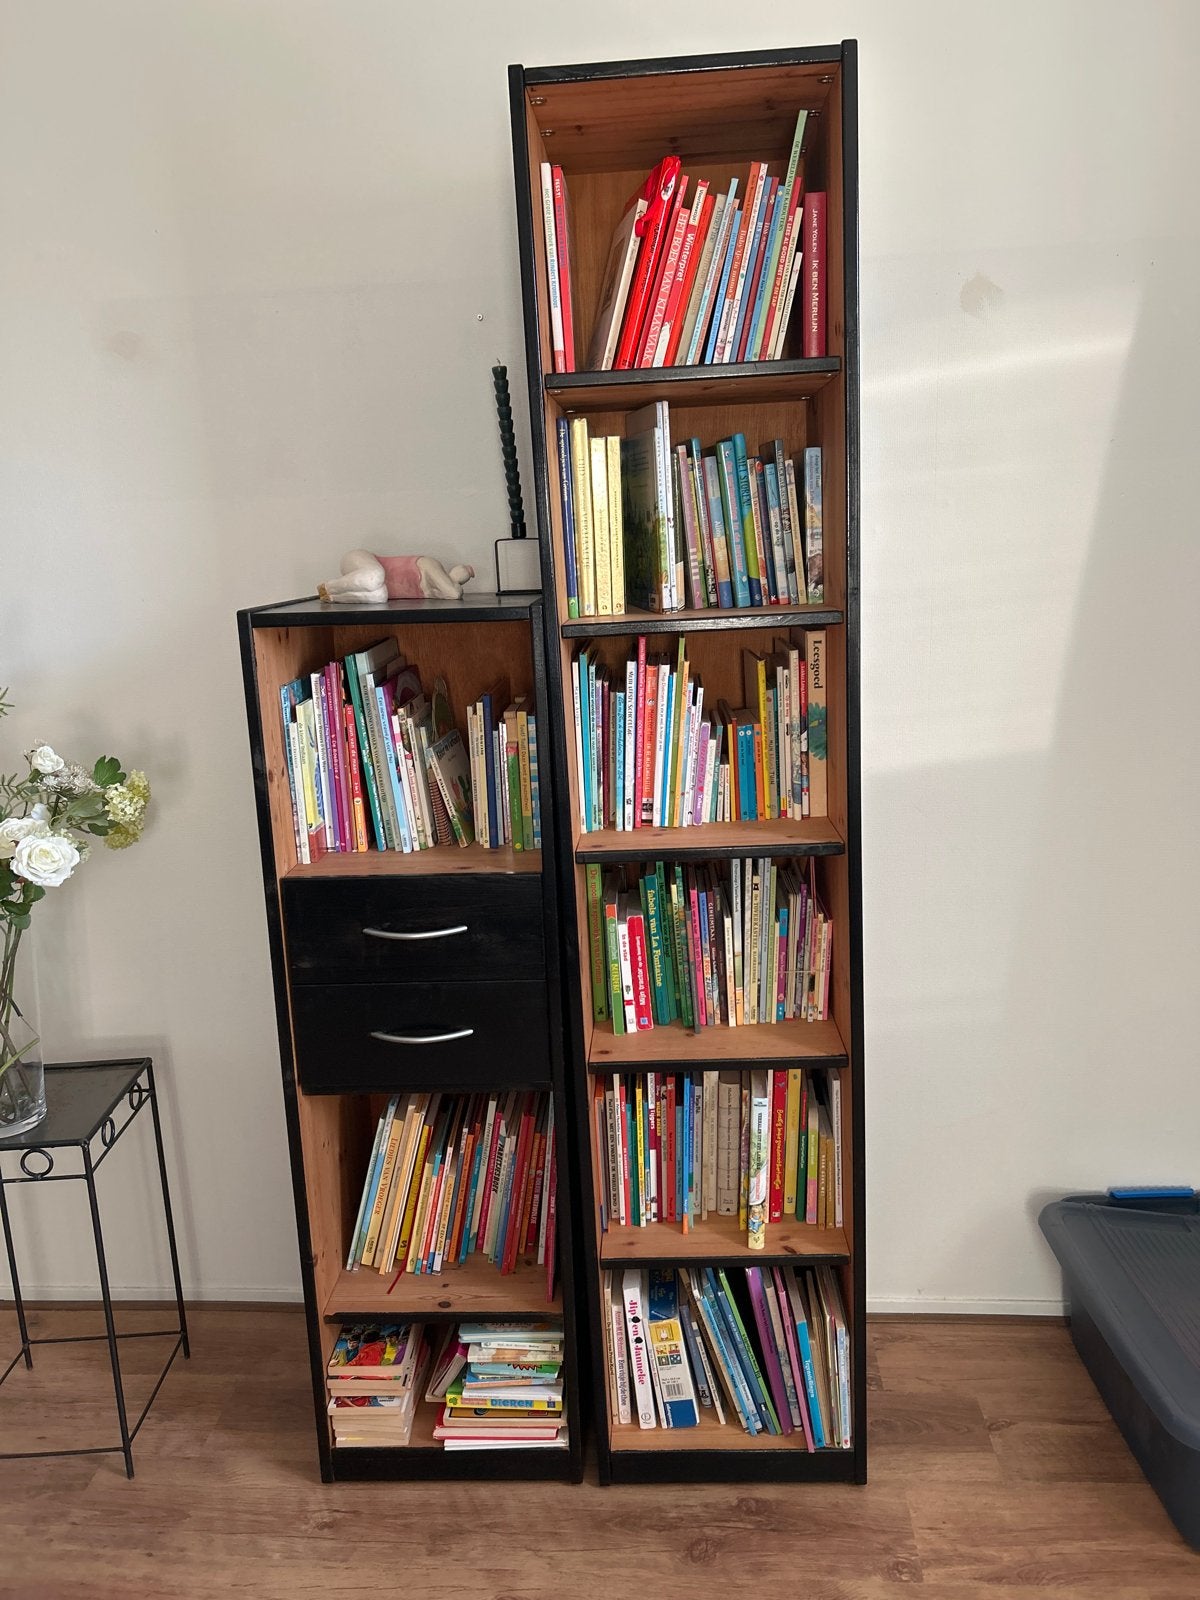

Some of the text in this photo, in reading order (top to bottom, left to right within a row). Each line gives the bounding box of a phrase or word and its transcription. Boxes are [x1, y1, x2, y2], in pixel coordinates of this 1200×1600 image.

[675, 232, 695, 282] Winterpret
[783, 236, 789, 245] AL
[551, 280, 559, 309] Kromhout
[643, 212, 688, 363] HET BOEK VAN KLAAS VAAK
[737, 455, 748, 473] NIET
[810, 640, 823, 689] Leesgoed
[647, 889, 663, 987] fabels van La Fontaine
[635, 968, 645, 990] tractor
[373, 1137, 399, 1215] LIEDJES VAN VROEGER
[627, 1299, 647, 1385] Jip en Janneke
